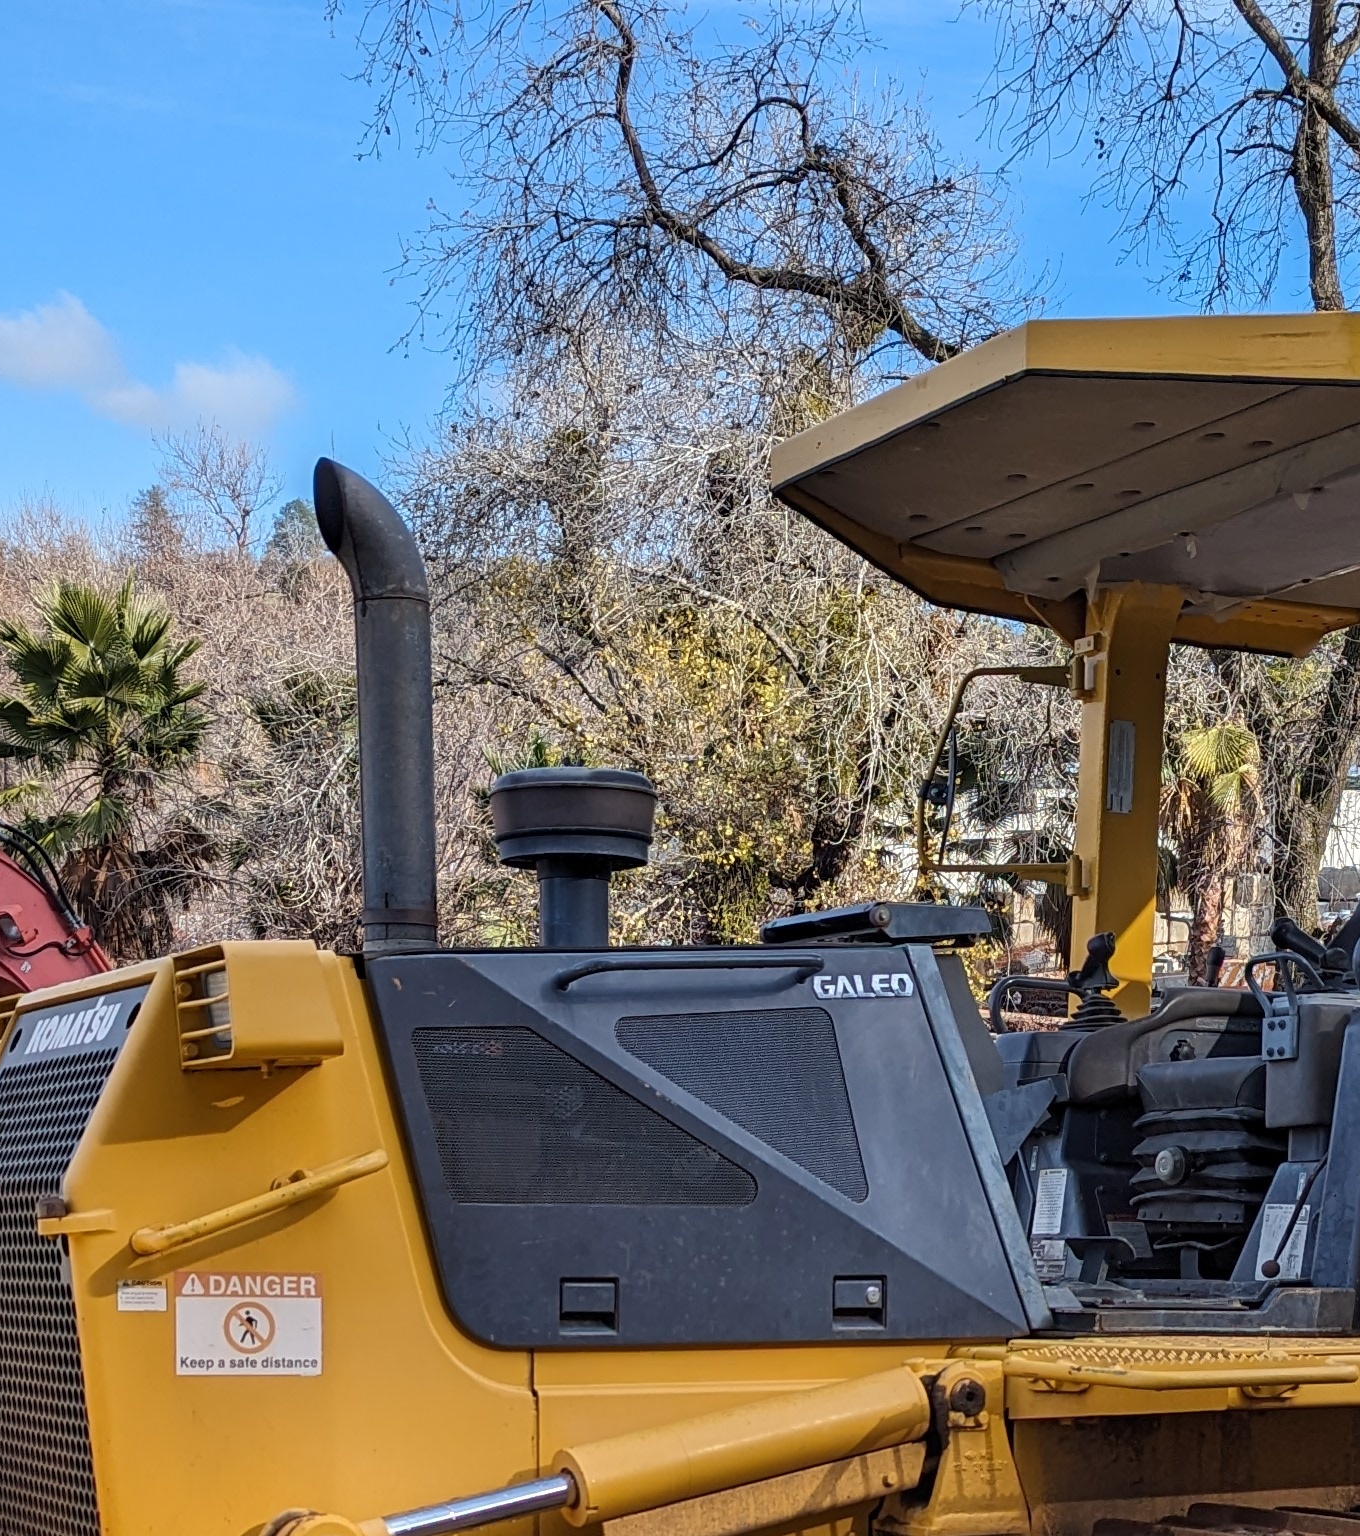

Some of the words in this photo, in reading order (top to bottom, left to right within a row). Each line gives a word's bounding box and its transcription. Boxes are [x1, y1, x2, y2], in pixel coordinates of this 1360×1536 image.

[813, 973, 914, 998] GALEO
[24, 996, 122, 1055] KOMATSU
[209, 1275, 316, 1296] DANGER
[180, 1356, 214, 1371] Keep
[218, 1359, 225, 1368] a
[229, 1356, 257, 1368] safe
[261, 1356, 318, 1368] distance
